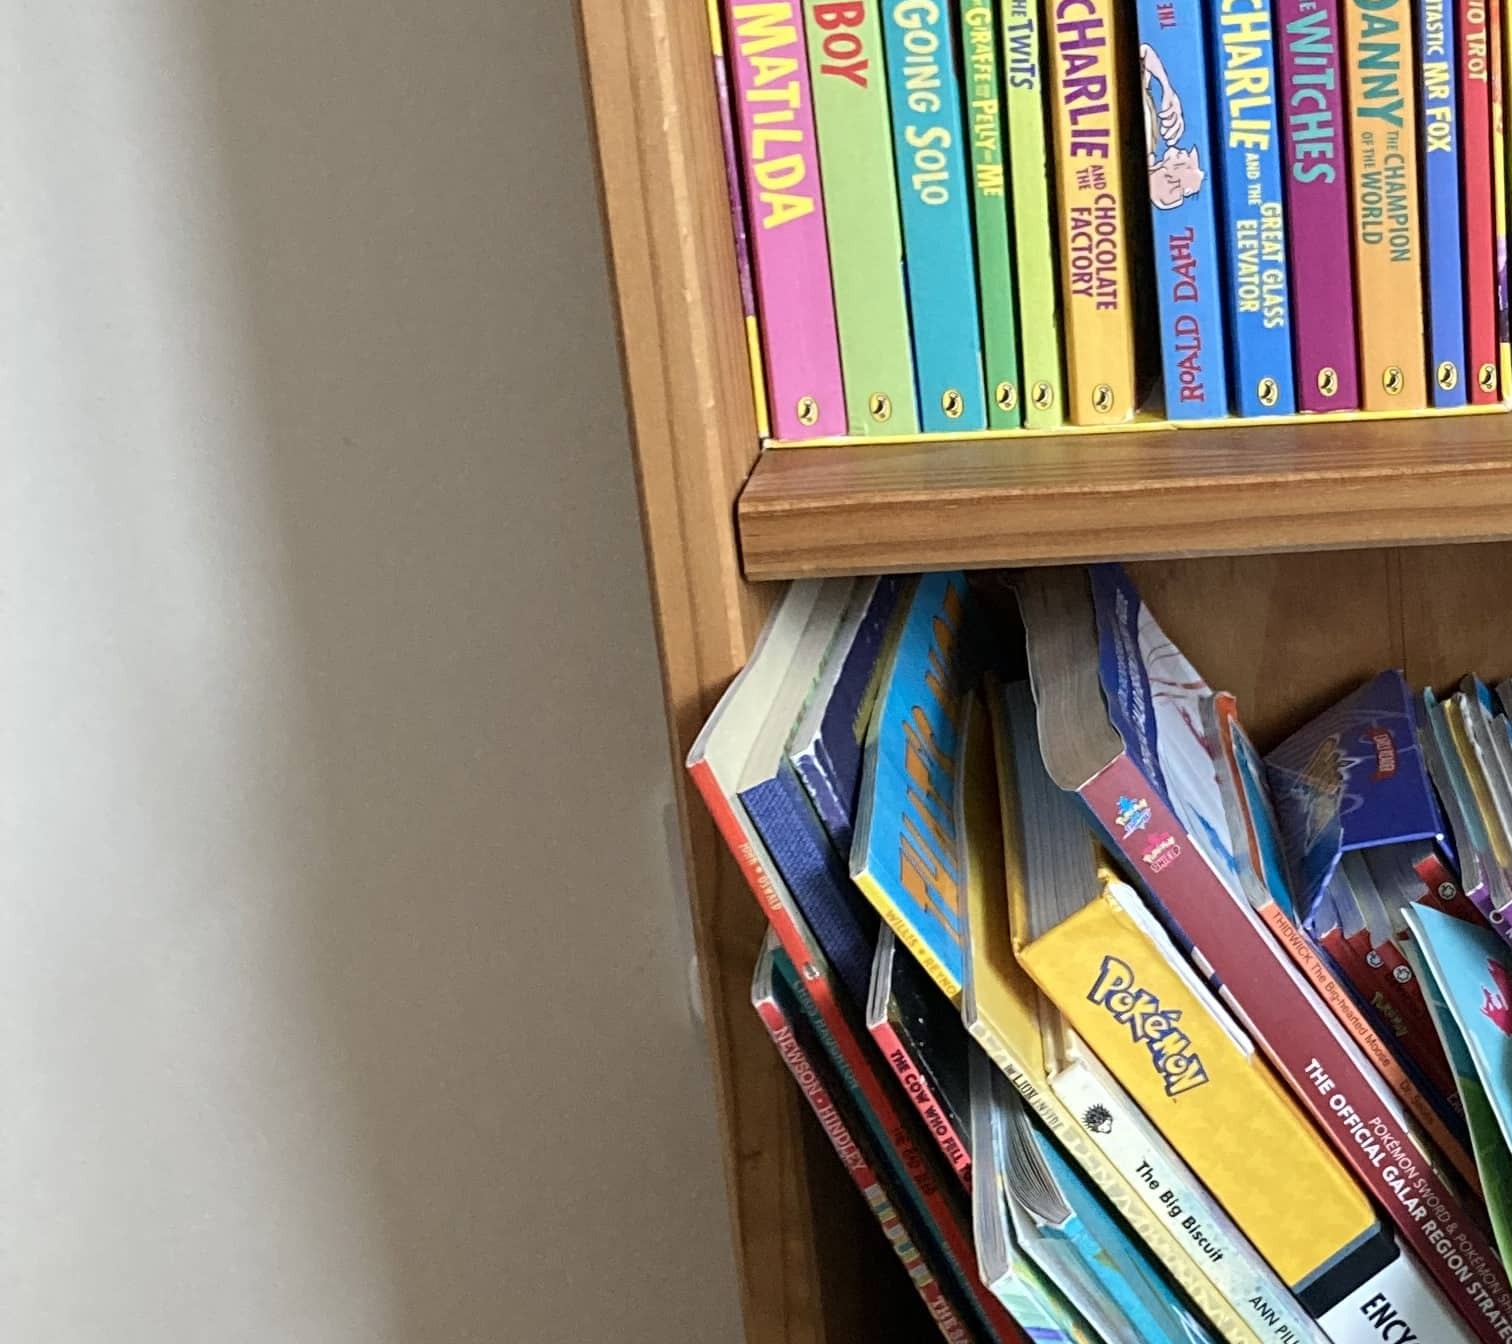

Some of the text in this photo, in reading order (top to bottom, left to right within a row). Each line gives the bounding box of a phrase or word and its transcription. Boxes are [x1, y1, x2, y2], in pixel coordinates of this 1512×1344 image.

[813, 1, 869, 88] BOY
[965, 7, 992, 81] GIRAFFE
[1008, 19, 1035, 90] TWITS
[1160, 3, 1176, 30] THE
[1286, 9, 1336, 184] WITCHES
[1423, 62, 1451, 99] MR
[1467, 32, 1487, 83] TROT
[731, 2, 814, 229] MATILDA
[972, 97, 999, 150] PELLY
[1386, 131, 1401, 152] THE
[1425, 106, 1453, 152] FOX
[905, 126, 951, 205] SOLO
[976, 164, 1003, 196] ME
[1245, 153, 1260, 179] AND
[1247, 183, 1262, 205] THE
[1360, 132, 1383, 244] OF THE WORLD
[1070, 168, 1095, 297] THE FACTORY
[1092, 164, 1118, 310] AND CHOCOLATE
[1261, 202, 1283, 262] GREAT
[1384, 153, 1410, 262] CHAMPION
[1236, 219, 1261, 312] ELEVATOR
[1263, 269, 1285, 328] GLASS
[1172, 227, 1205, 403] ROALD DAHL
[1273, 912, 1390, 1067] THIDWICK The Big-hearted Moose
[891, 1049, 911, 1073] THE
[904, 1073, 929, 1103] COW
[924, 1105, 947, 1135] WHO
[942, 1136, 963, 1164] FELL
[1305, 1058, 1332, 1096] THE
[1329, 1093, 1382, 1168] OFFICIAL
[1382, 1166, 1426, 1222] GALAR
[1420, 1219, 1470, 1283] REGION
[1369, 1116, 1419, 1178] POKÉMON
[1417, 1177, 1451, 1223] SWORD
[1136, 1160, 1223, 1262] The Big Biscuit
[1248, 1296, 1280, 1326] ANN
